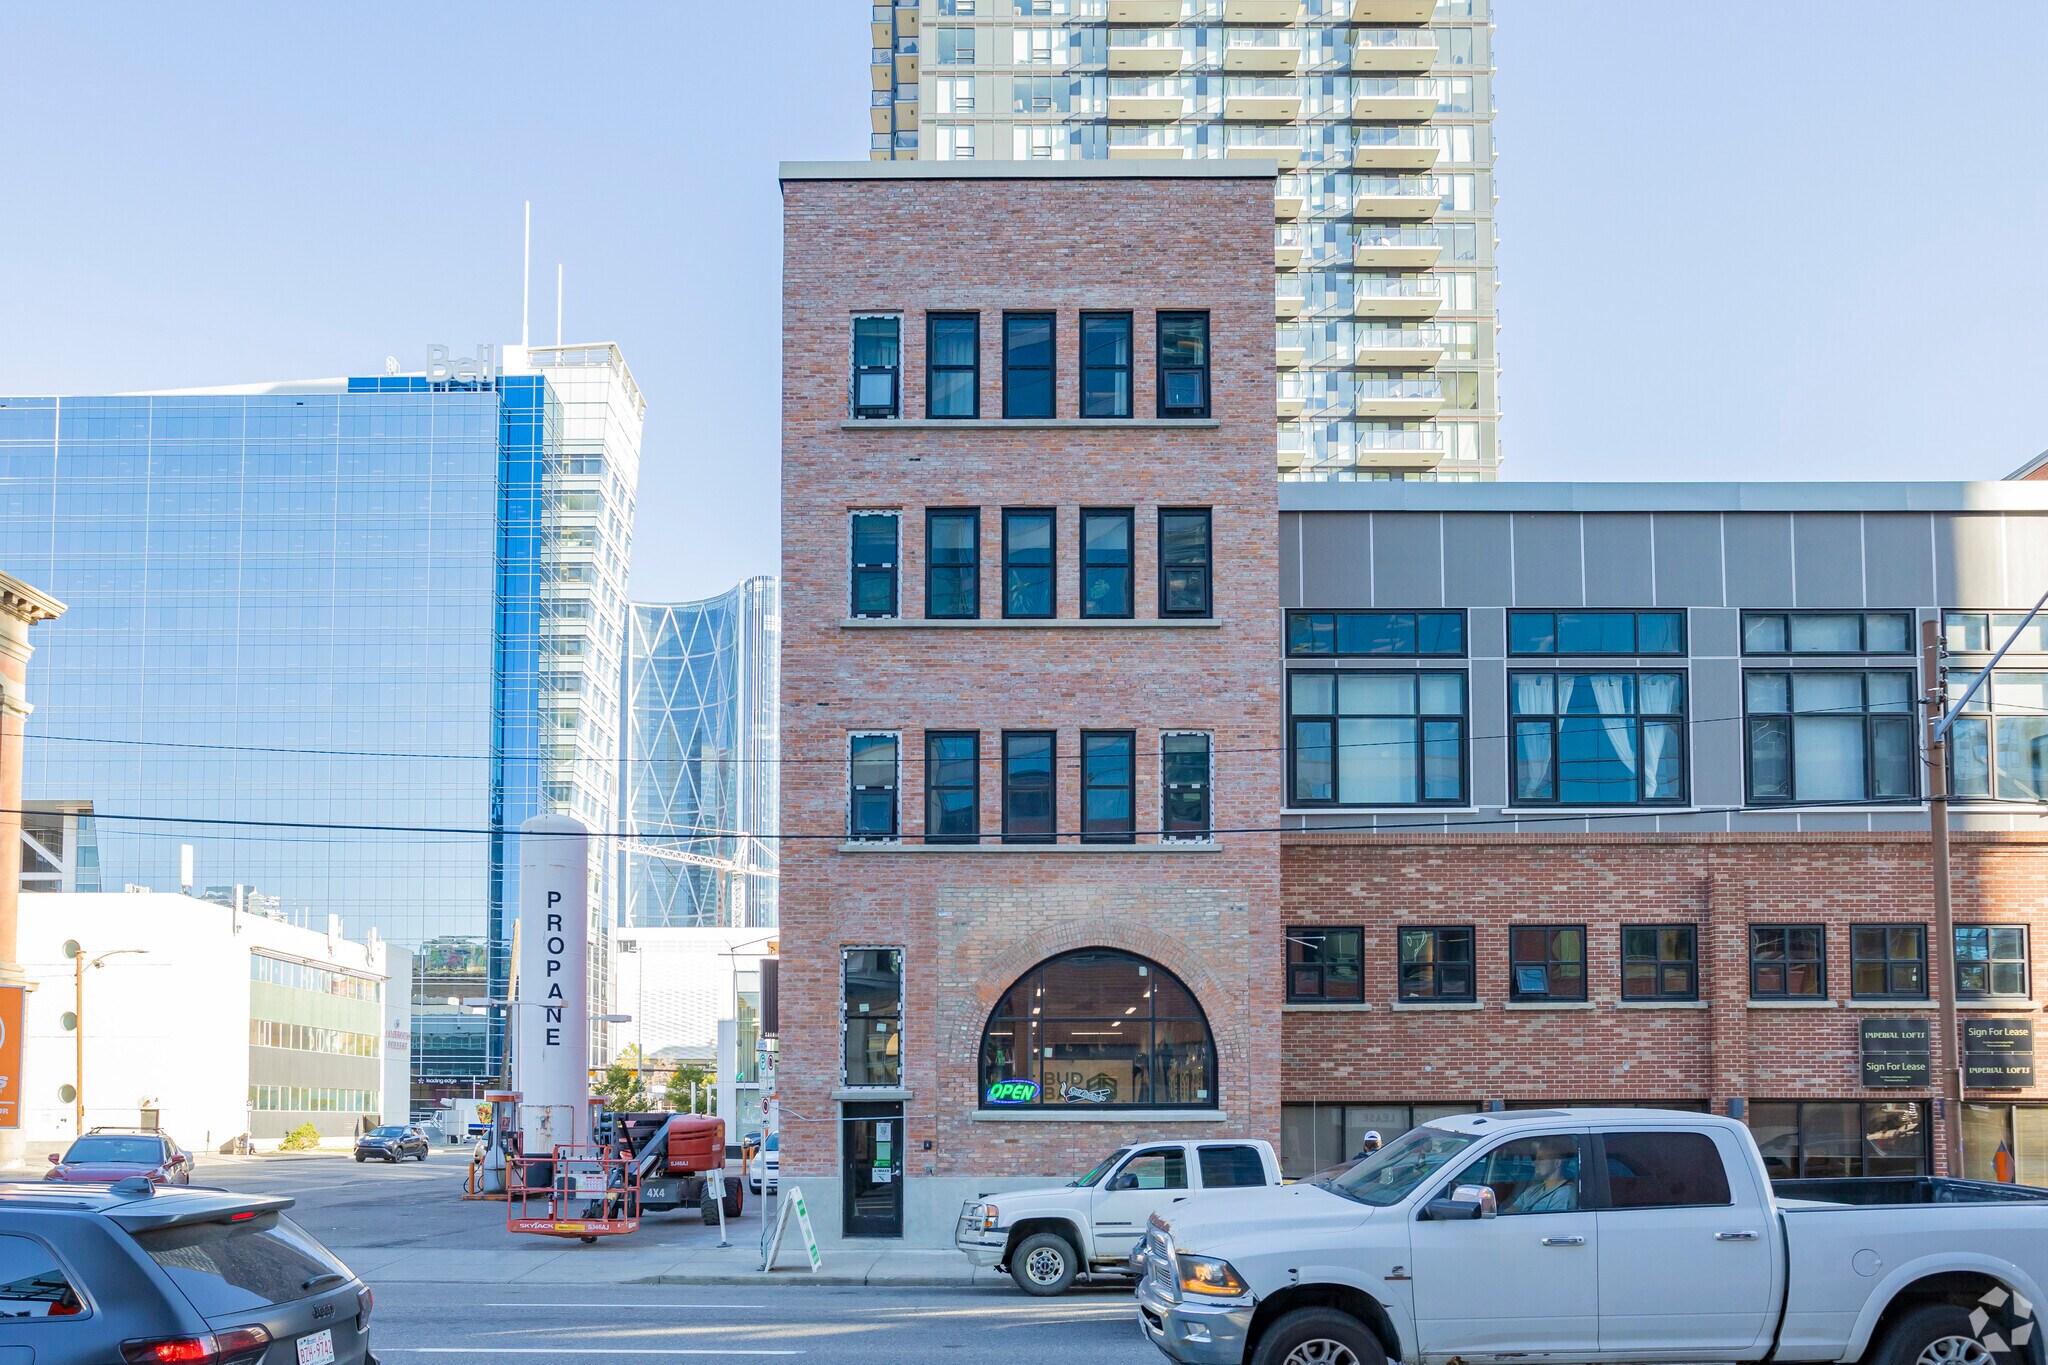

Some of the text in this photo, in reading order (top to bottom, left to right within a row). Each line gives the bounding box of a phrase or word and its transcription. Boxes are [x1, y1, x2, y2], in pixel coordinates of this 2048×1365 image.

[427, 344, 494, 382] Bell
[546, 891, 564, 1045] PROPANE
[1968, 1028, 1987, 1037] Sign
[1866, 1062, 1885, 1072] Sign
[1044, 1072, 1083, 1086] BUD
[990, 1083, 1035, 1100] OPEN
[647, 1188, 665, 1197] 4X4
